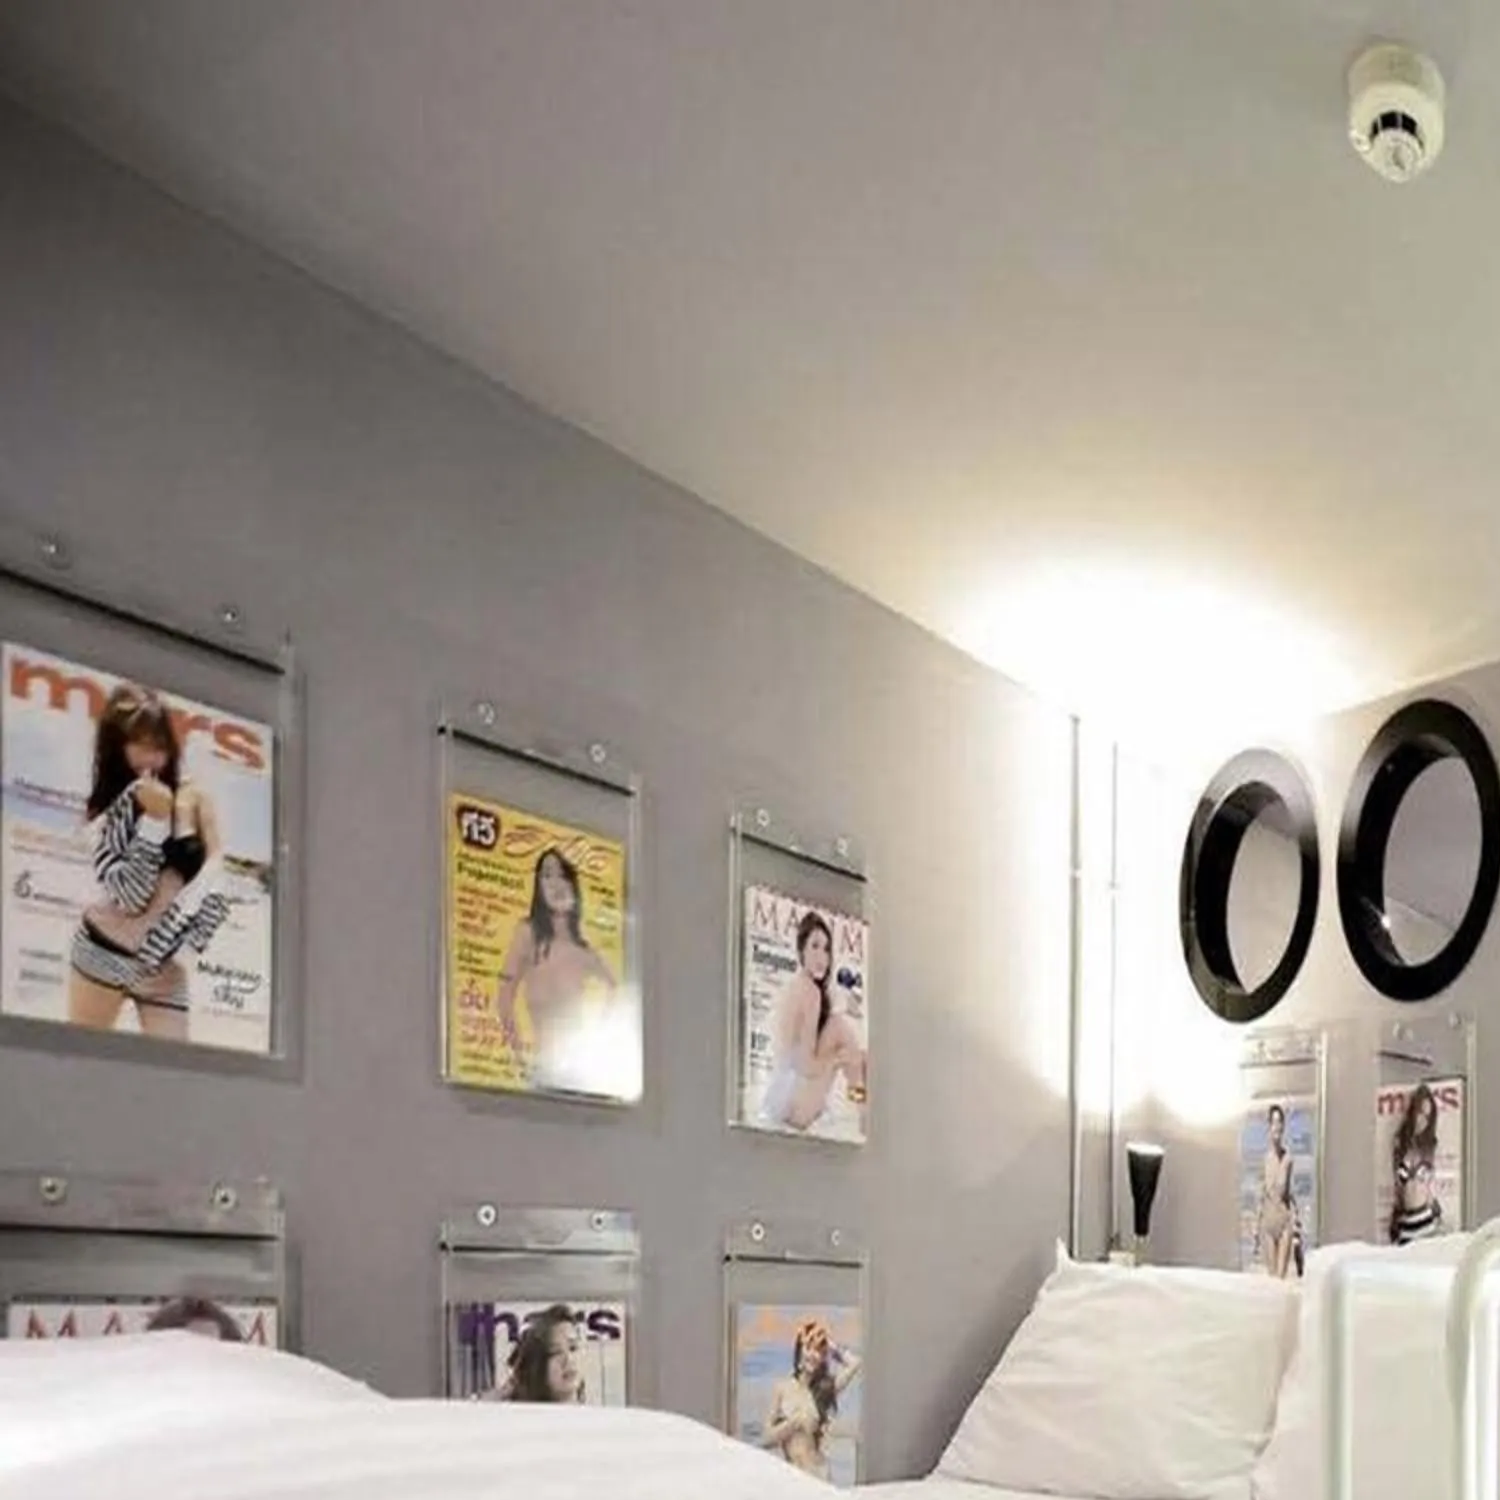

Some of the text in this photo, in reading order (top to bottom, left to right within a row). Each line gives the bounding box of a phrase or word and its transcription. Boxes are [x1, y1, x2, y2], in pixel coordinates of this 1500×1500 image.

[9, 658, 265, 770] mrs
[753, 897, 863, 958] MAM
[1378, 1086, 1459, 1116] ms
[457, 1303, 620, 1343] ms
